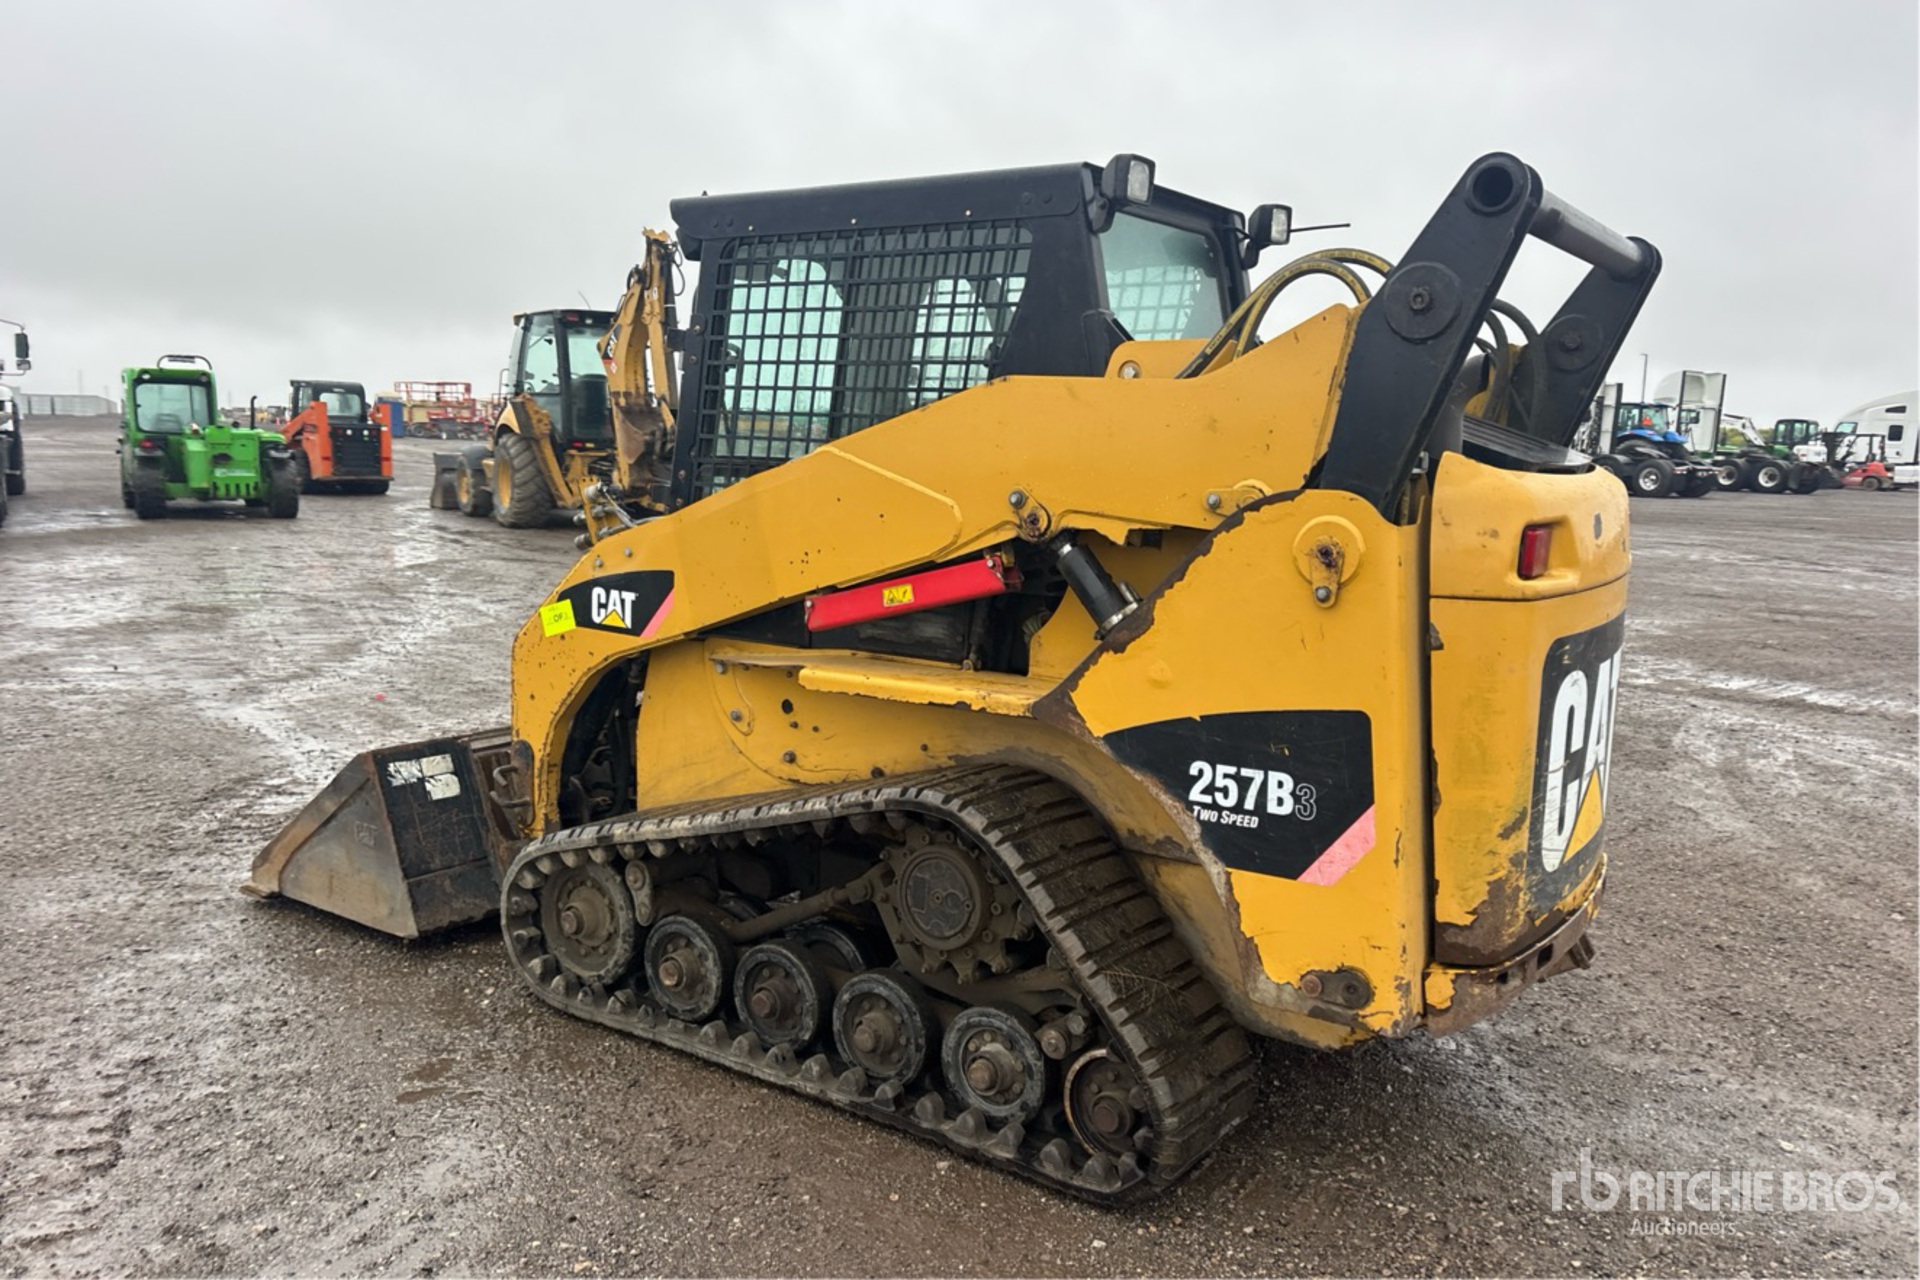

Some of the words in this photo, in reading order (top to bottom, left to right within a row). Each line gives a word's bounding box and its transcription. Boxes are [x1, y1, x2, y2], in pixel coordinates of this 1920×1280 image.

[591, 586, 635, 629] CAT
[1192, 805, 1218, 823] TWO
[1220, 810, 1259, 828] SPEED
